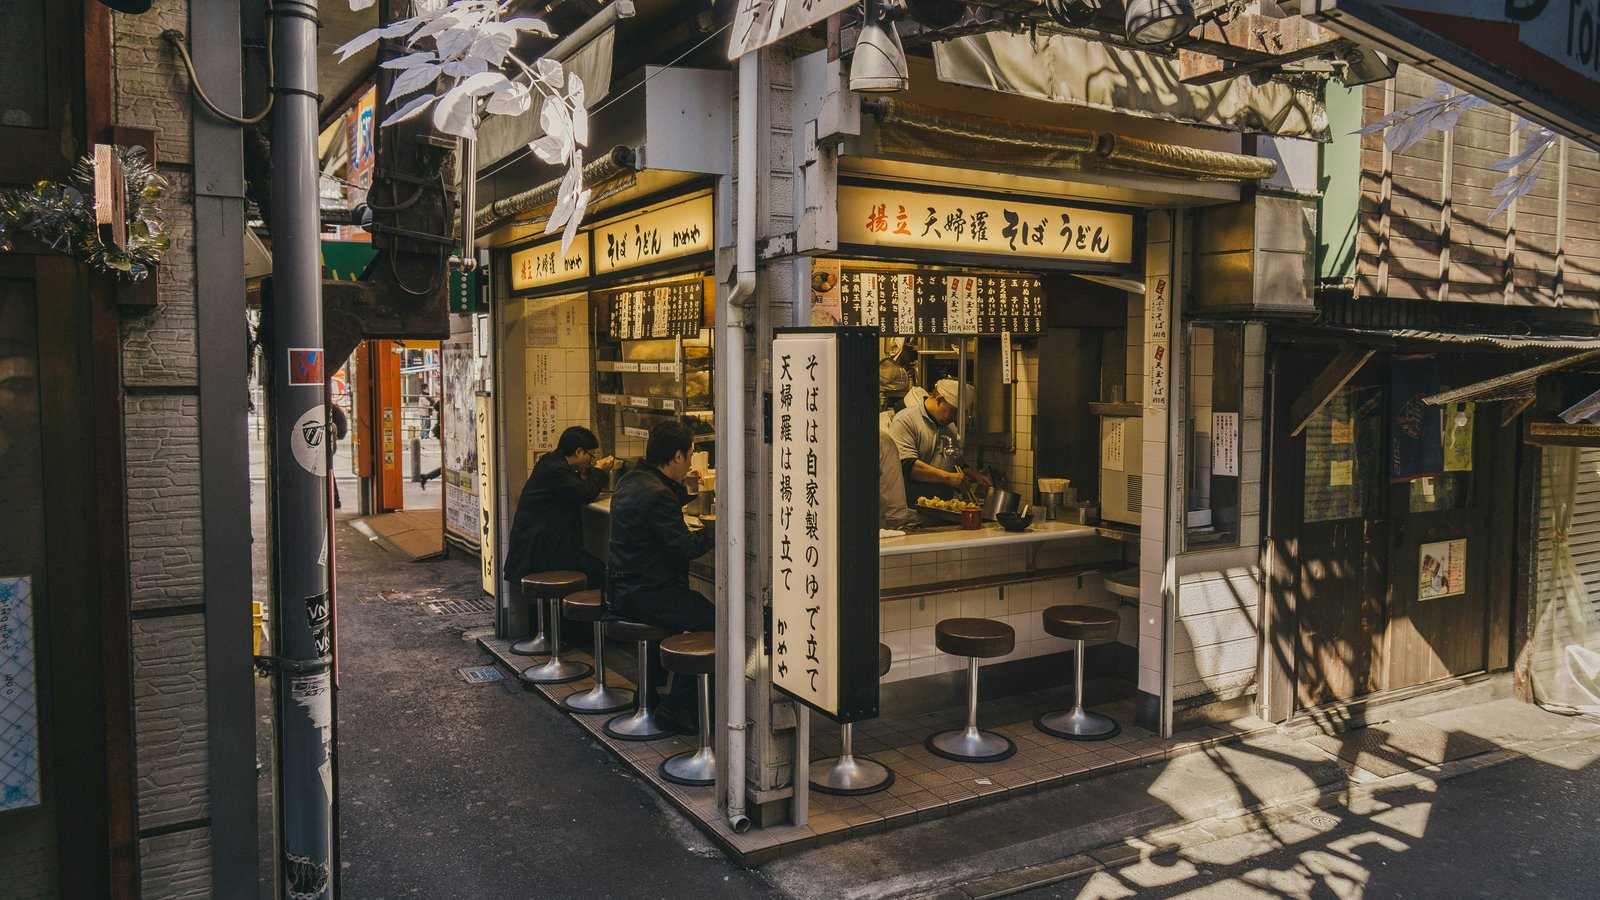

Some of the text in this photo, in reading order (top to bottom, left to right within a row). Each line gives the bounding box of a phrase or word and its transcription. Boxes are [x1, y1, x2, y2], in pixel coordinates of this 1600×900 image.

[606, 223, 702, 268] そば うどん かめや
[865, 203, 1110, 254] 揚立 天婦羅 そば うどん
[776, 354, 794, 679] 天婦羅は揚げ立て かめや
[804, 354, 820, 693] そばは自家製のゆで立て
